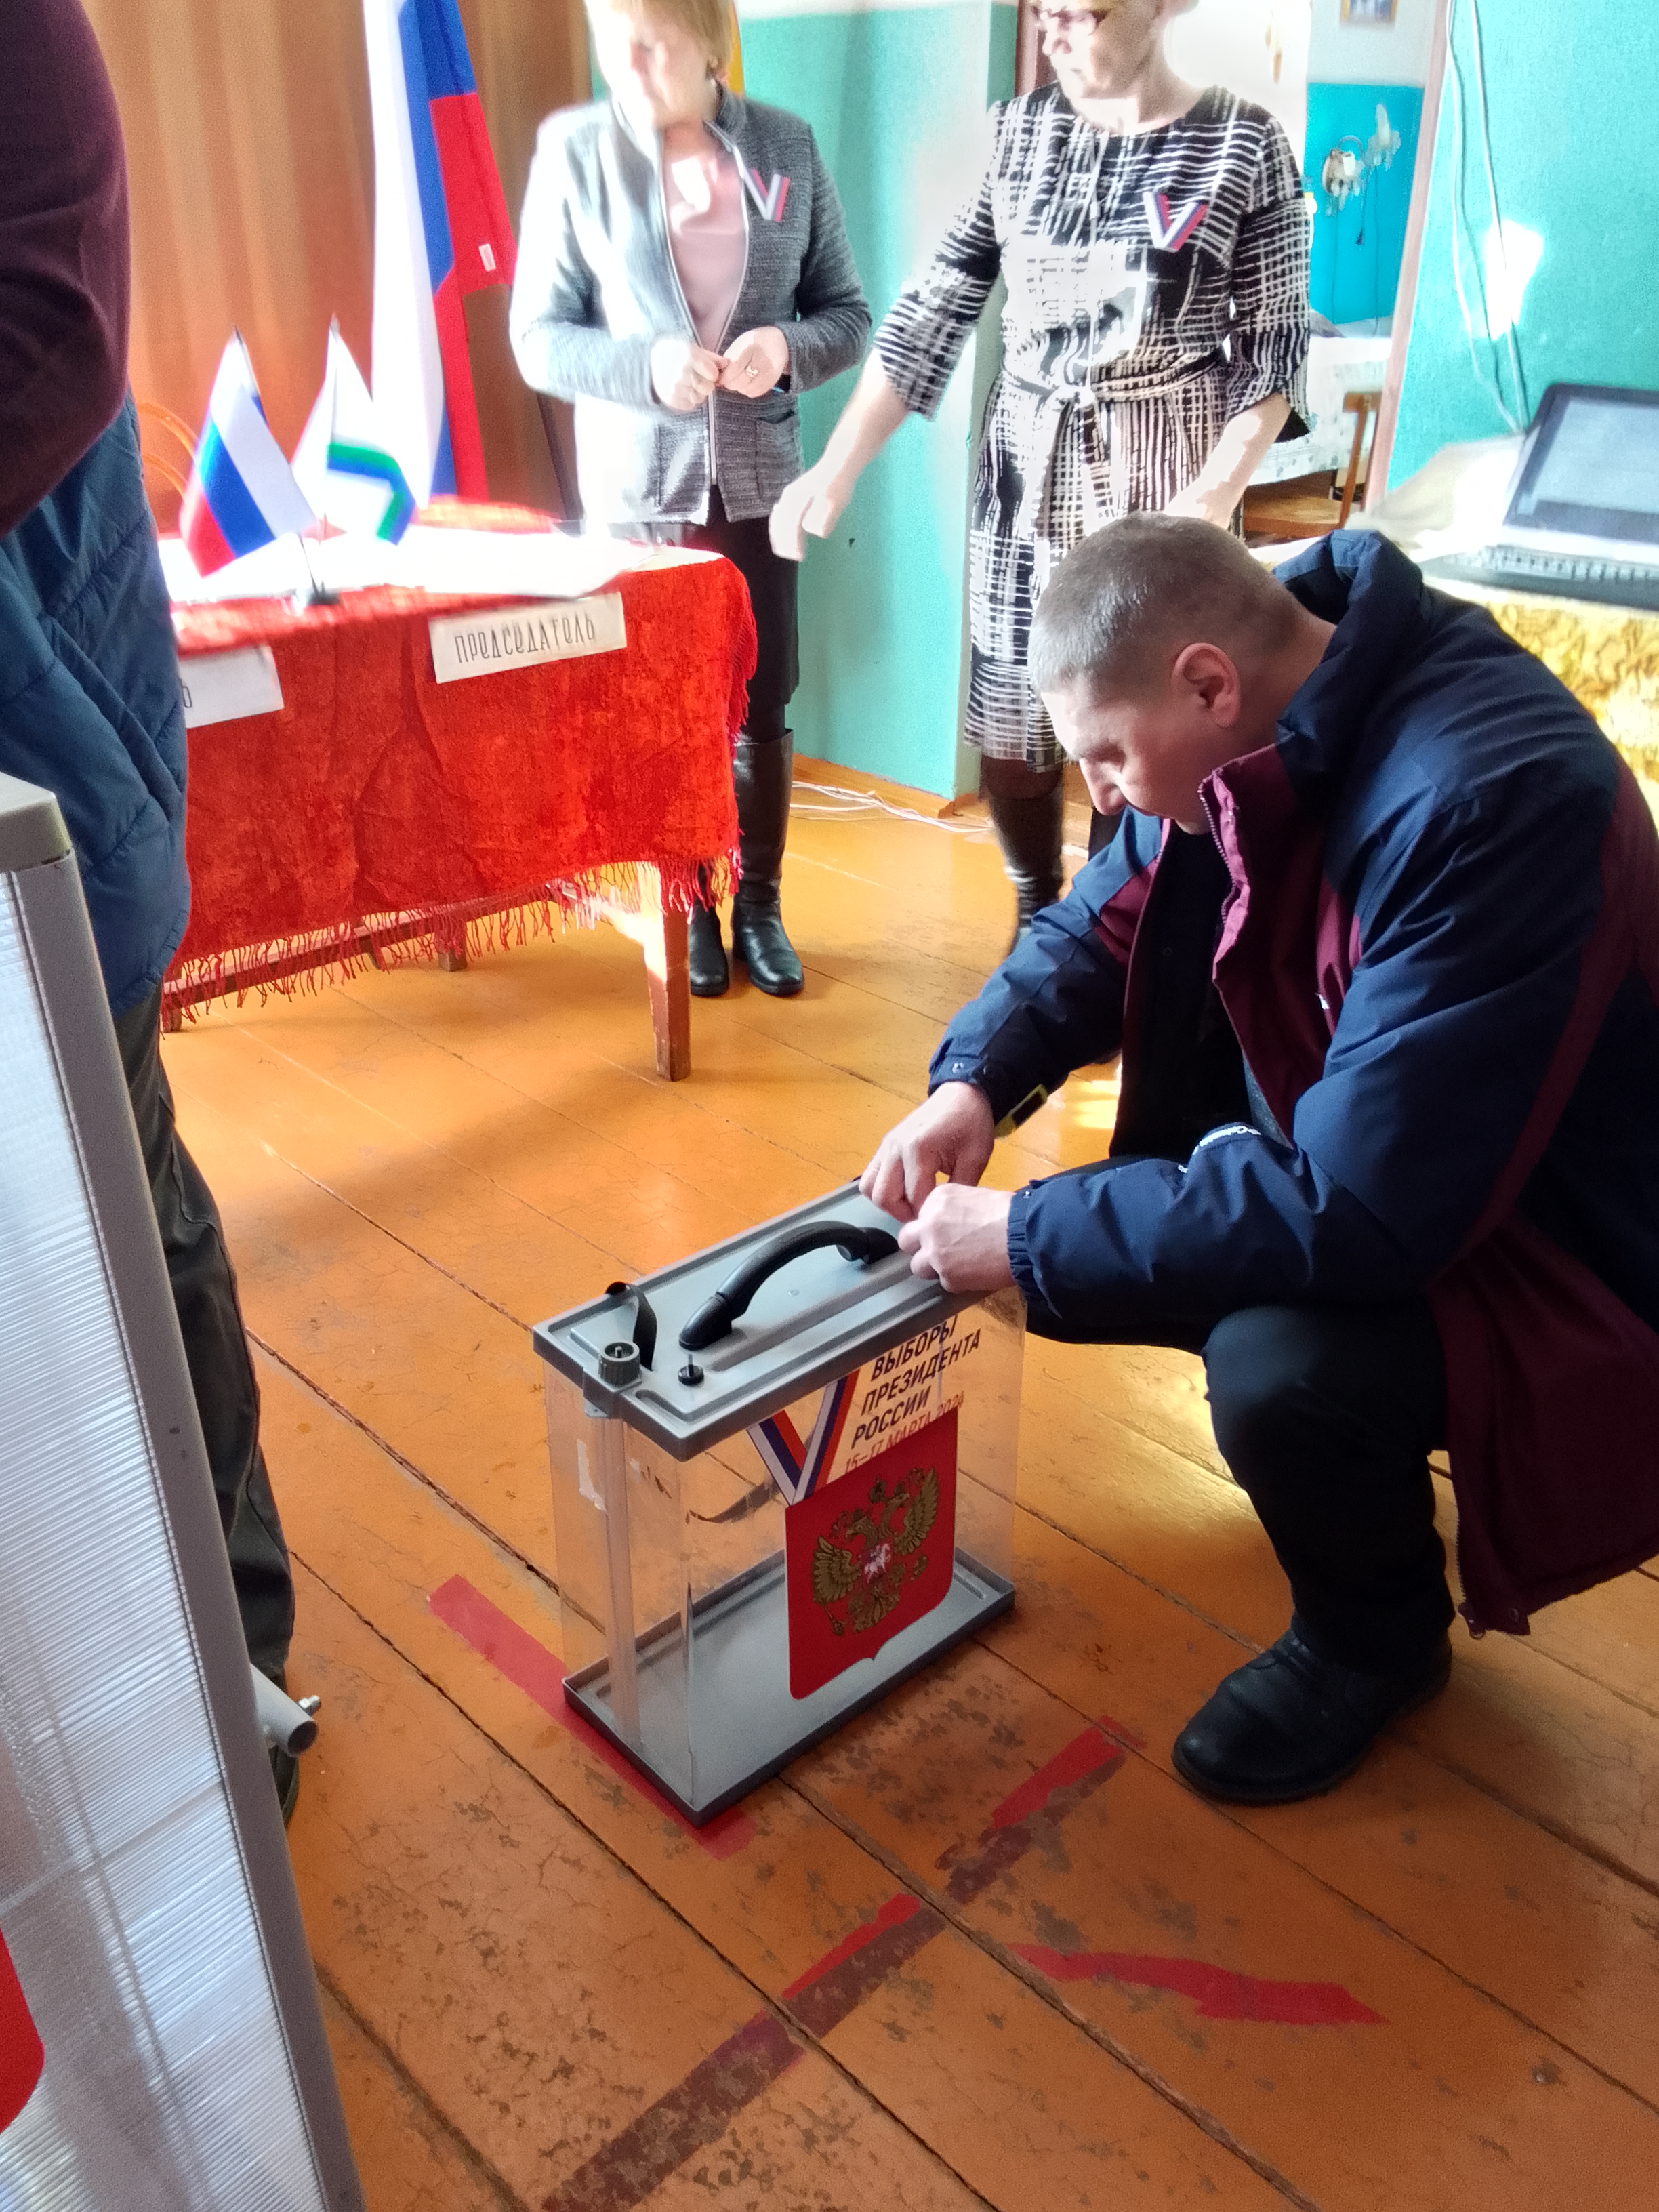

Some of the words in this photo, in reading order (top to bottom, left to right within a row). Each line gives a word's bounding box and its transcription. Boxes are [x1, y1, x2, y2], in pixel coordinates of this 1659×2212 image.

[861, 1328, 981, 1416] ПРЕЗИДЕНТА
[870, 1314, 958, 1382] ВЫБОРЫ
[851, 1385, 932, 1450] РОССИИ
